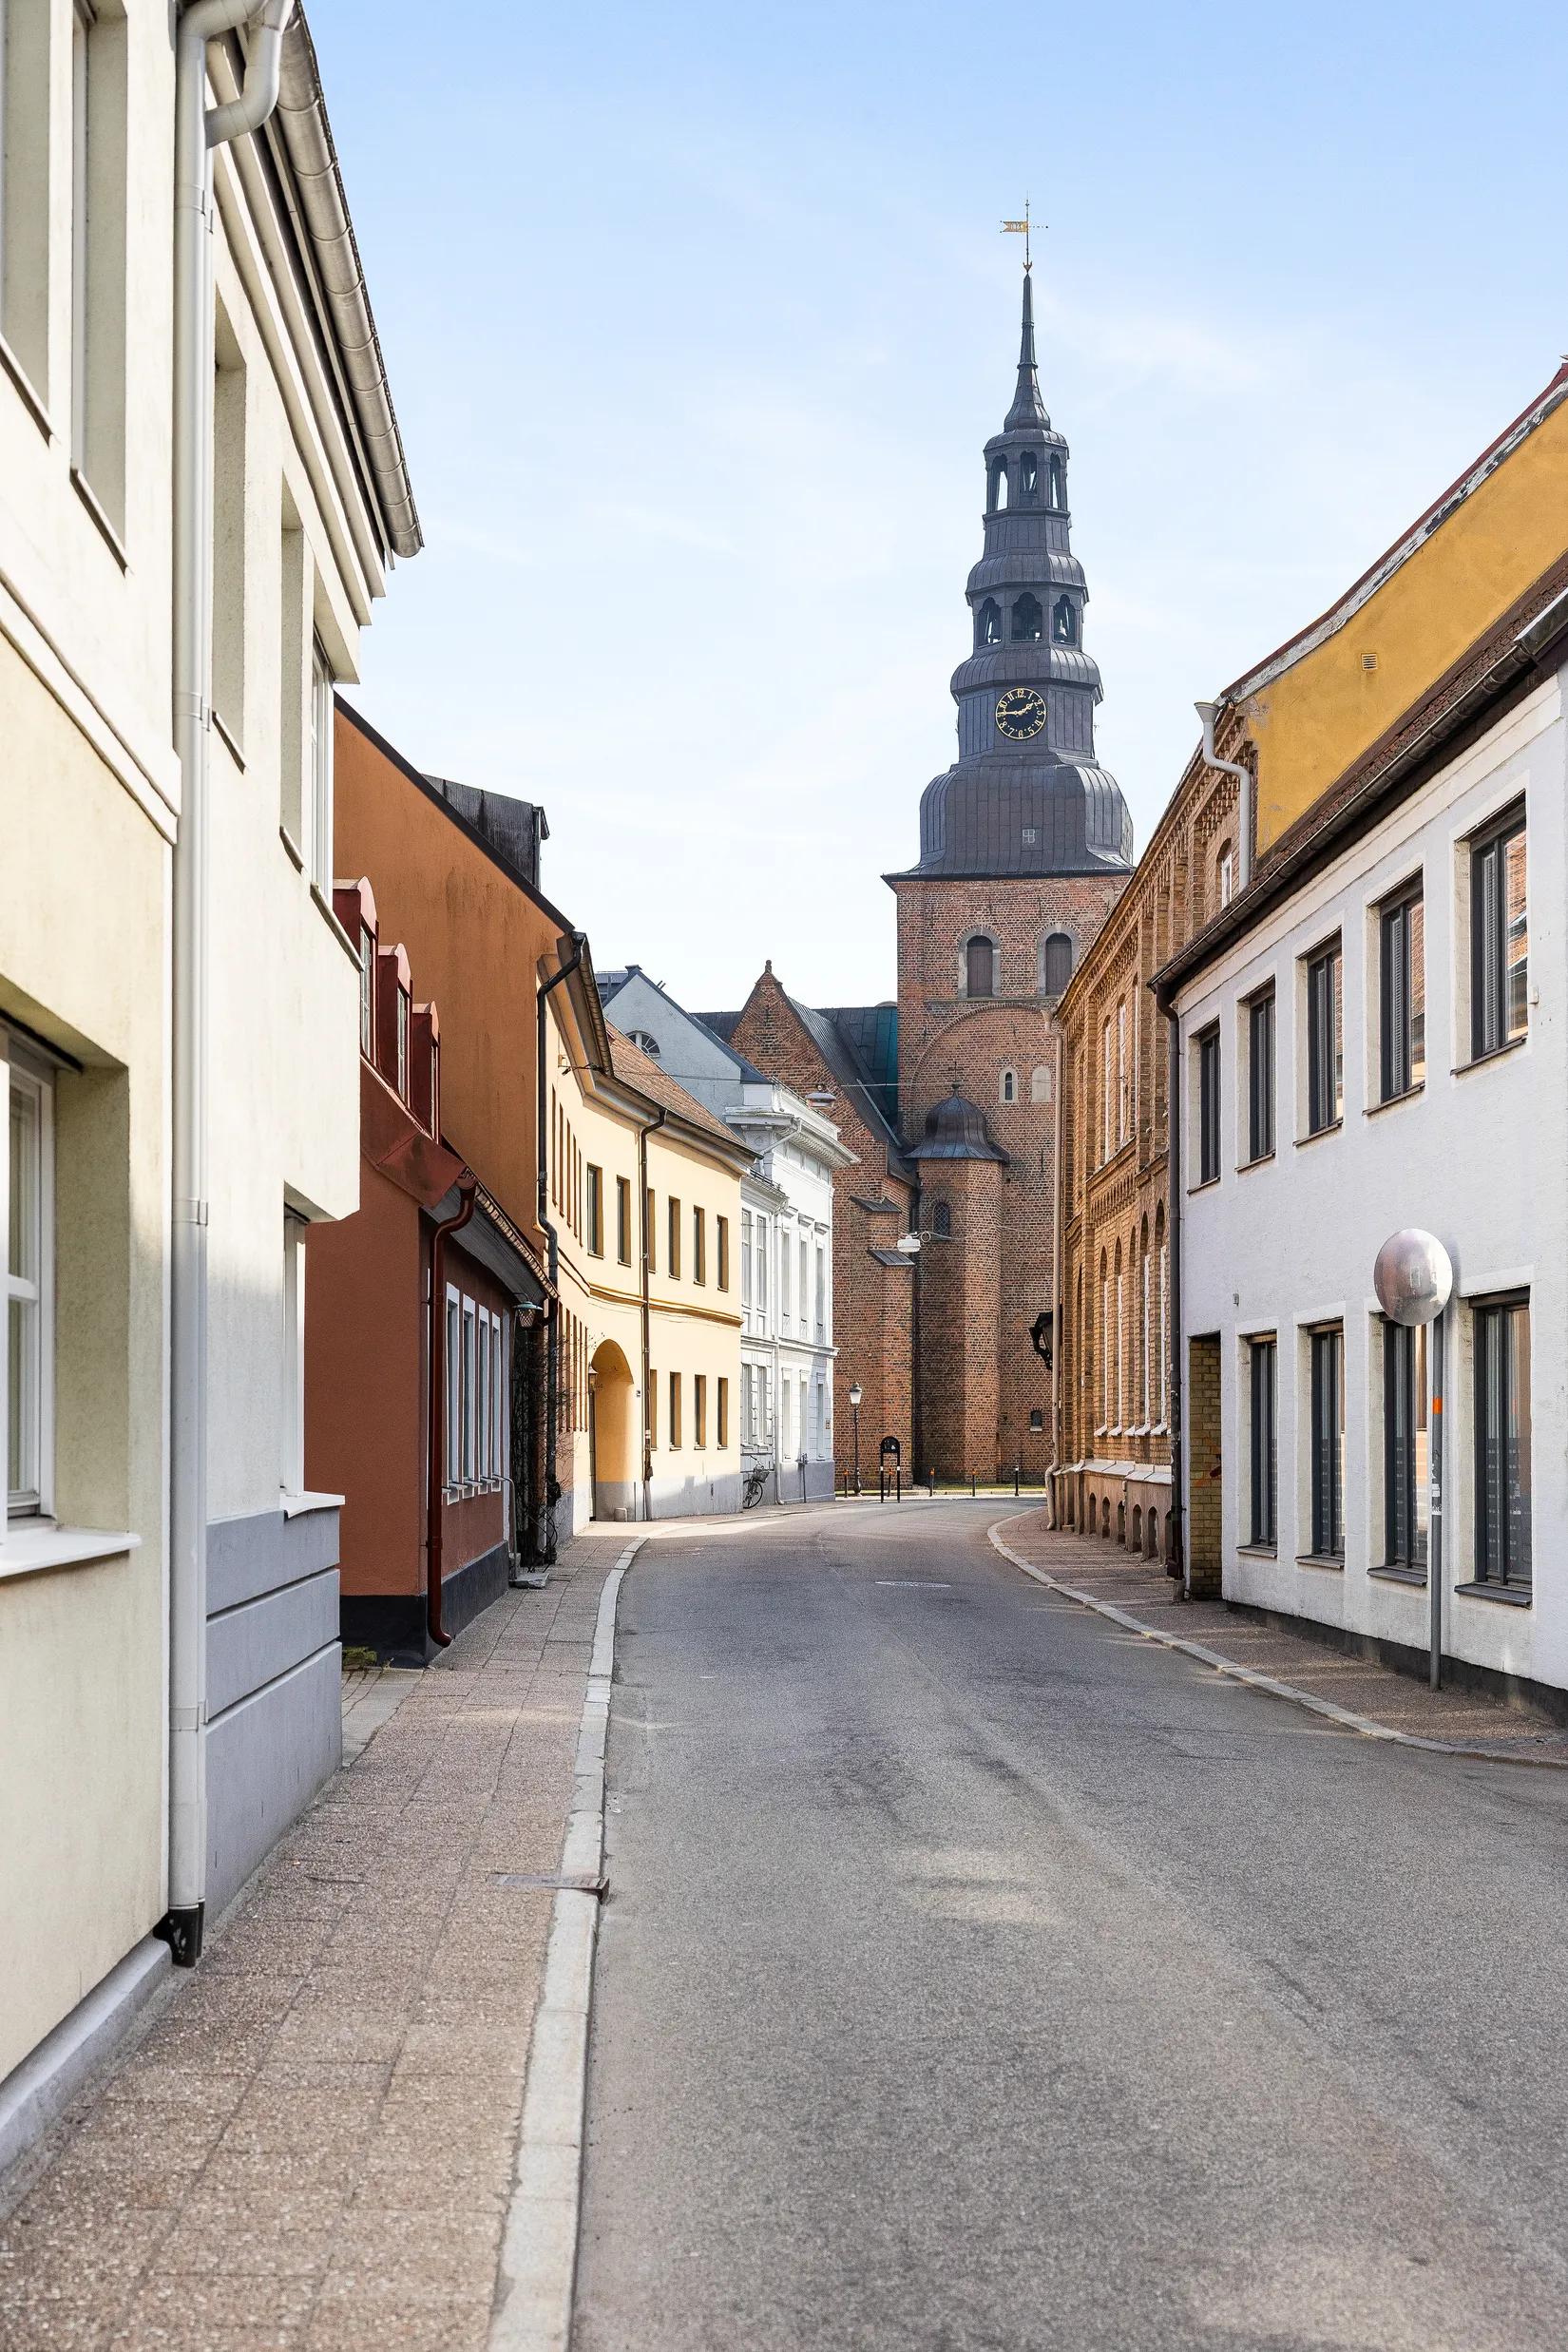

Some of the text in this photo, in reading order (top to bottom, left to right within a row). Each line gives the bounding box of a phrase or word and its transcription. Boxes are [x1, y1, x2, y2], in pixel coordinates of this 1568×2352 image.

[1007, 692, 1015, 701] 11
[1017, 689, 1024, 698] 12
[1027, 691, 1034, 699] 1
[999, 700, 1007, 709] 10
[1033, 698, 1042, 707] 2
[1007, 727, 1015, 736] 7
[1018, 729, 1023, 738] 6
[1027, 726, 1035, 736] 5
